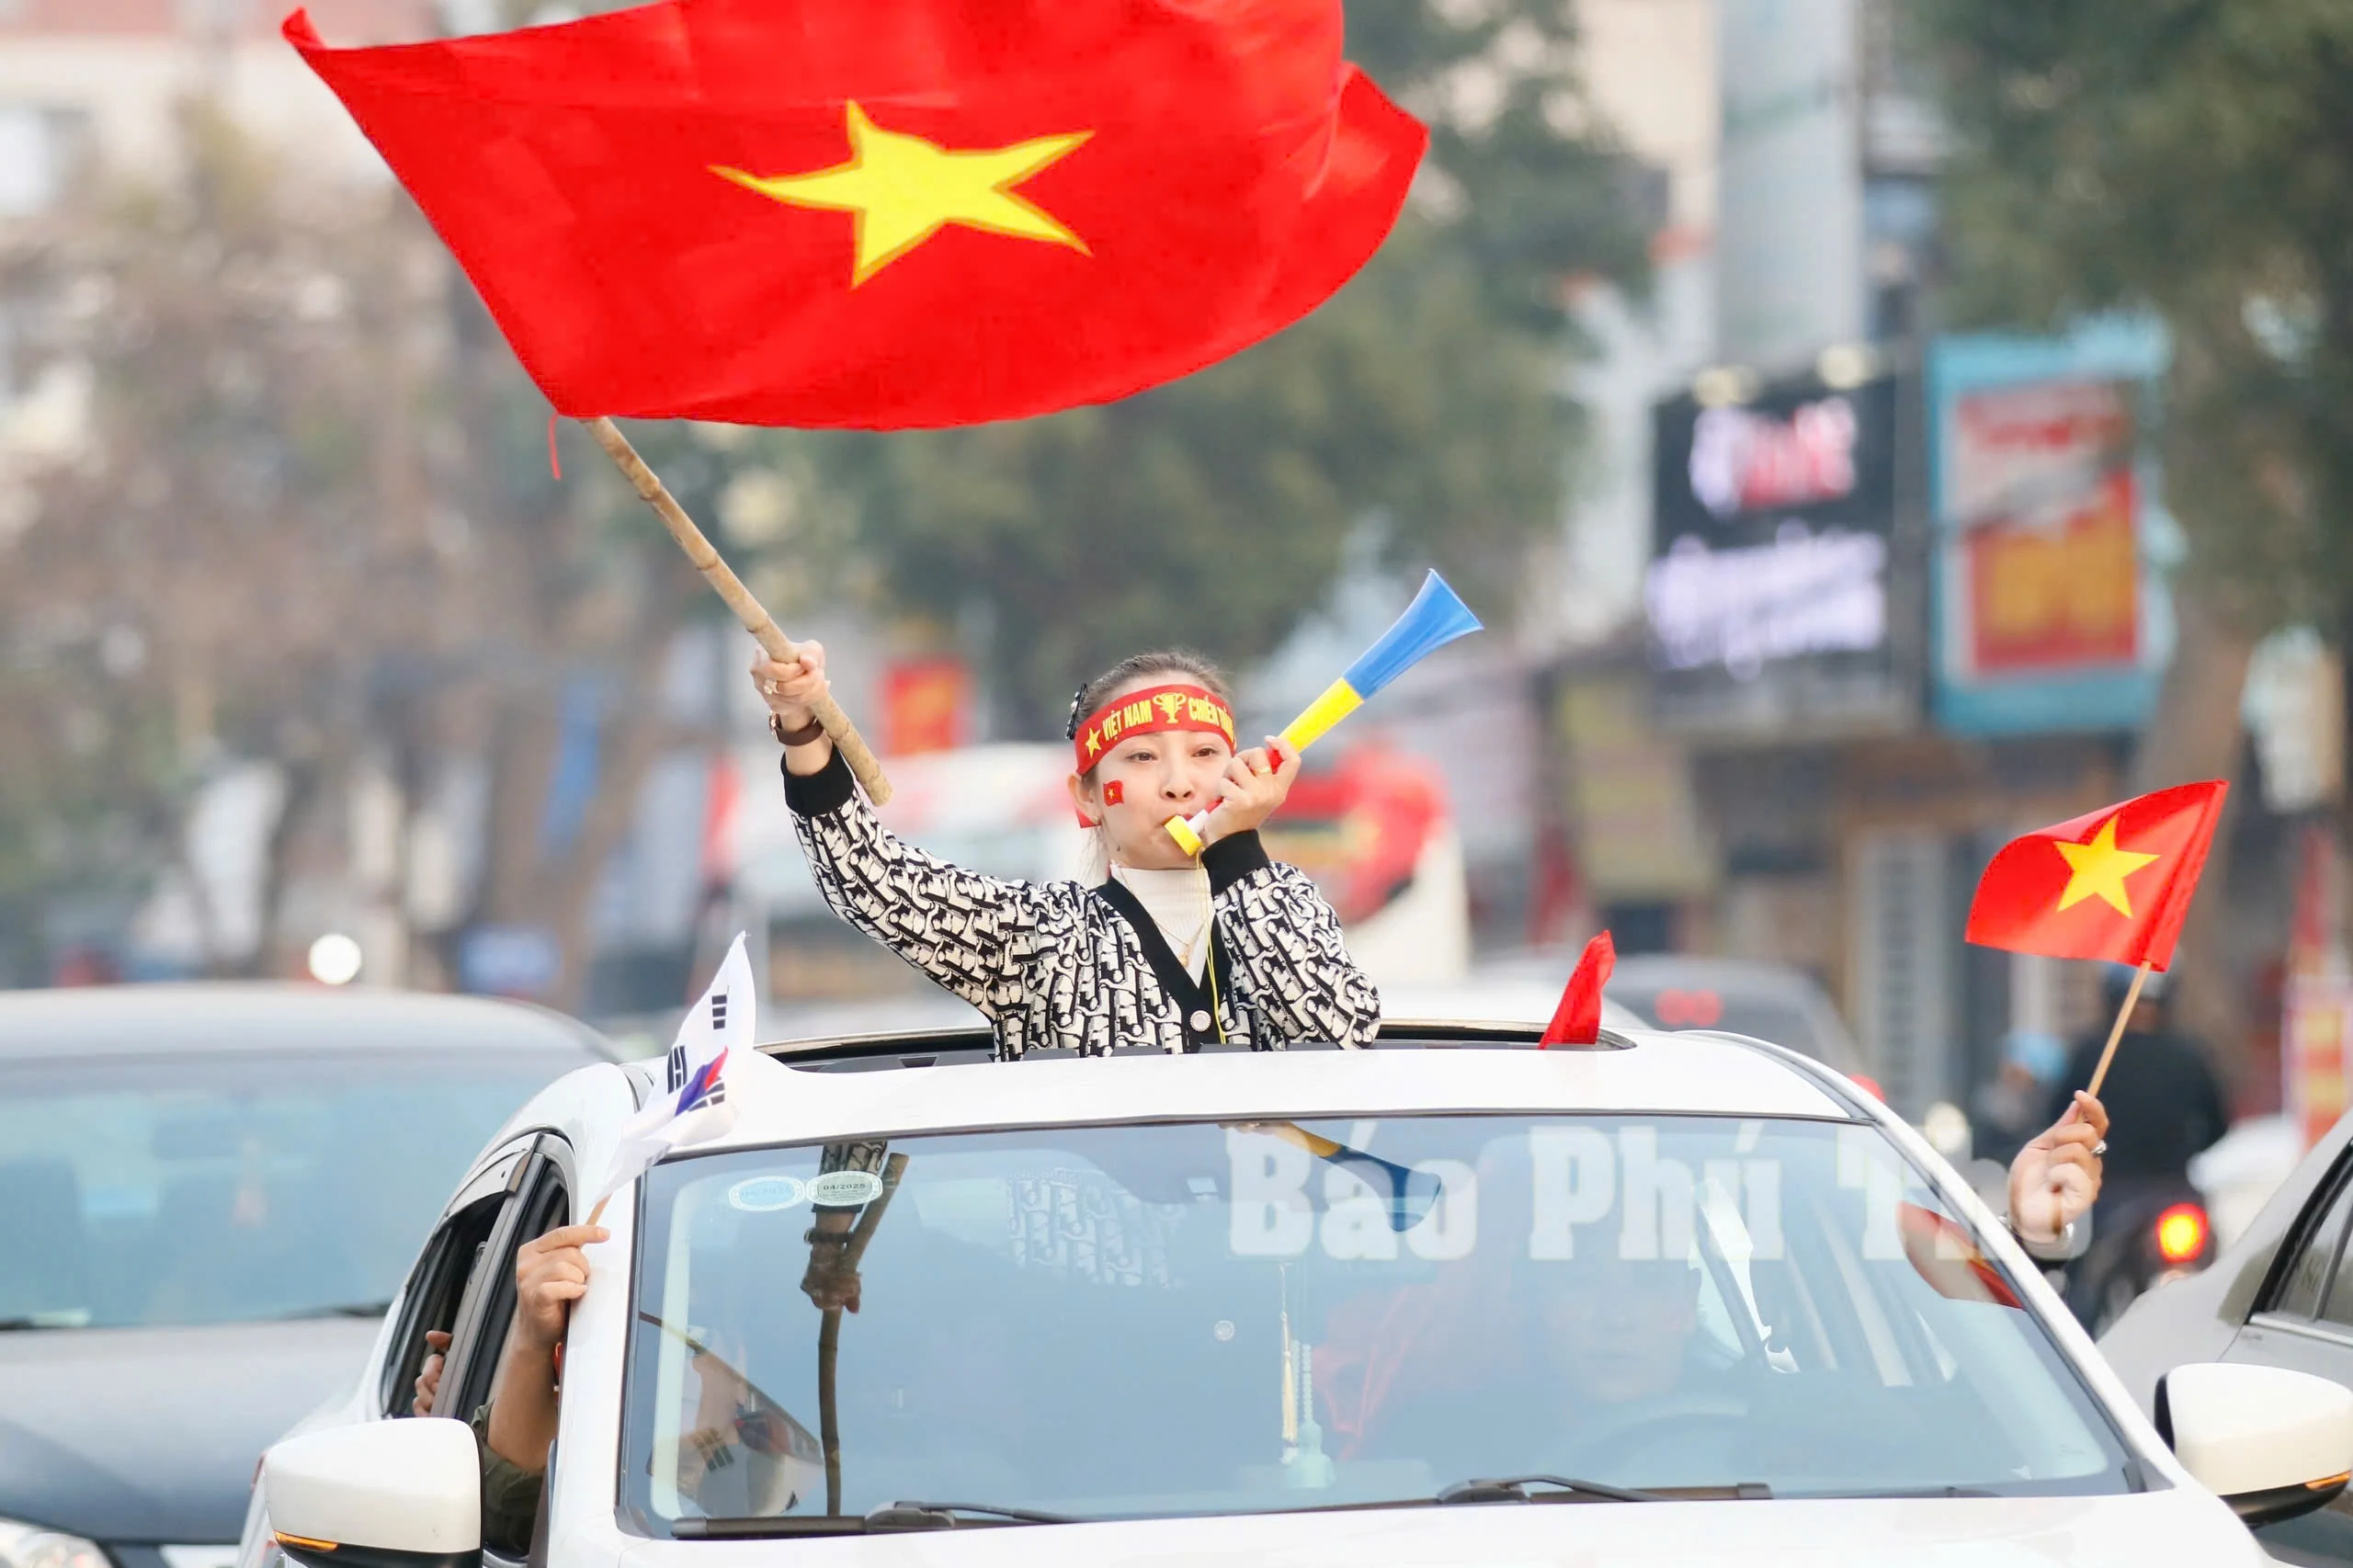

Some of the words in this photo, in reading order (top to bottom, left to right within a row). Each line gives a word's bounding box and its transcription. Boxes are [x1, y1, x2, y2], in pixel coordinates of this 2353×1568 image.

[1102, 710, 1122, 742] VIỆT
[1123, 699, 1154, 729] NAM
[823, 1183, 867, 1191] 04/2025
